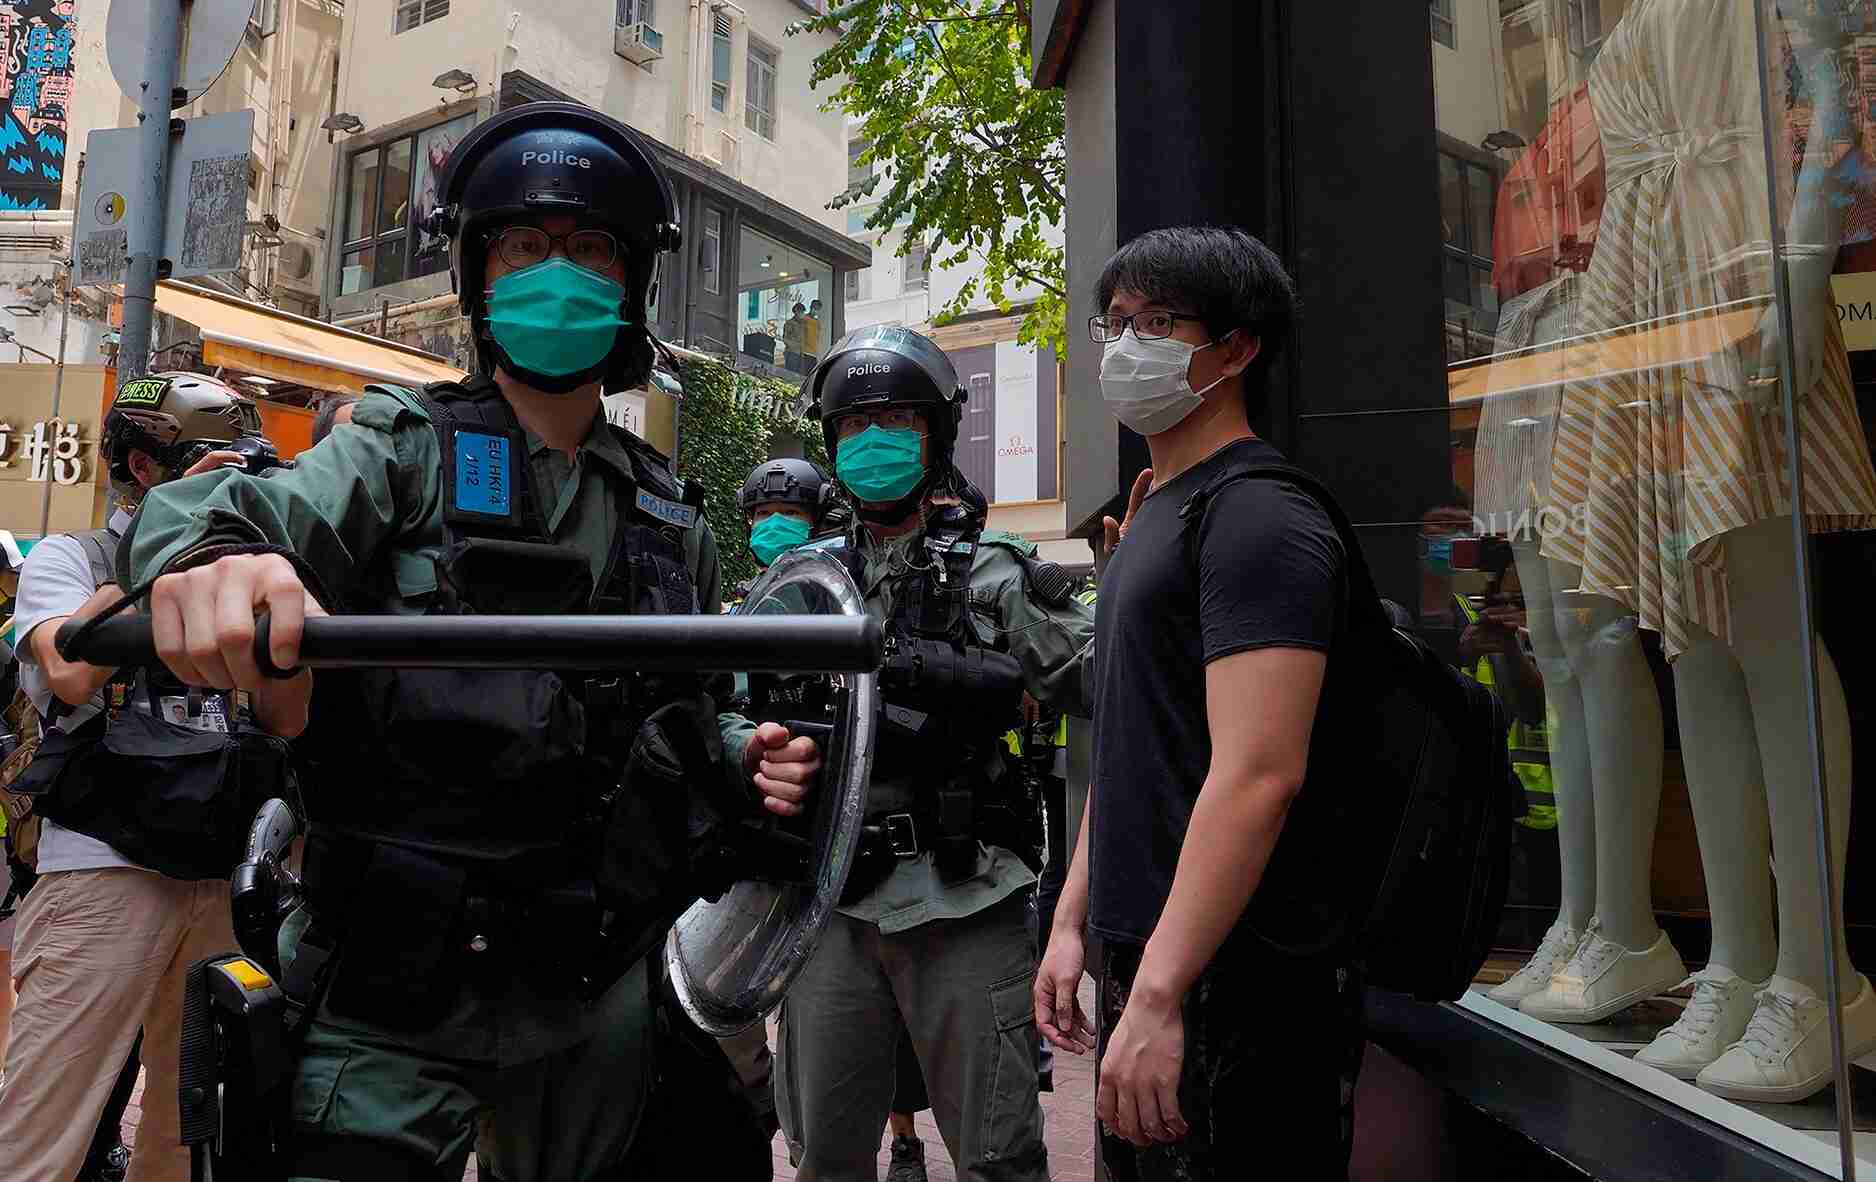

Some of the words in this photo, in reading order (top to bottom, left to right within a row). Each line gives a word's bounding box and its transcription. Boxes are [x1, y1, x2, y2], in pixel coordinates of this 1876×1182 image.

[522, 150, 591, 168] Police
[848, 363, 890, 378] Police
[640, 495, 690, 521] POLICE
